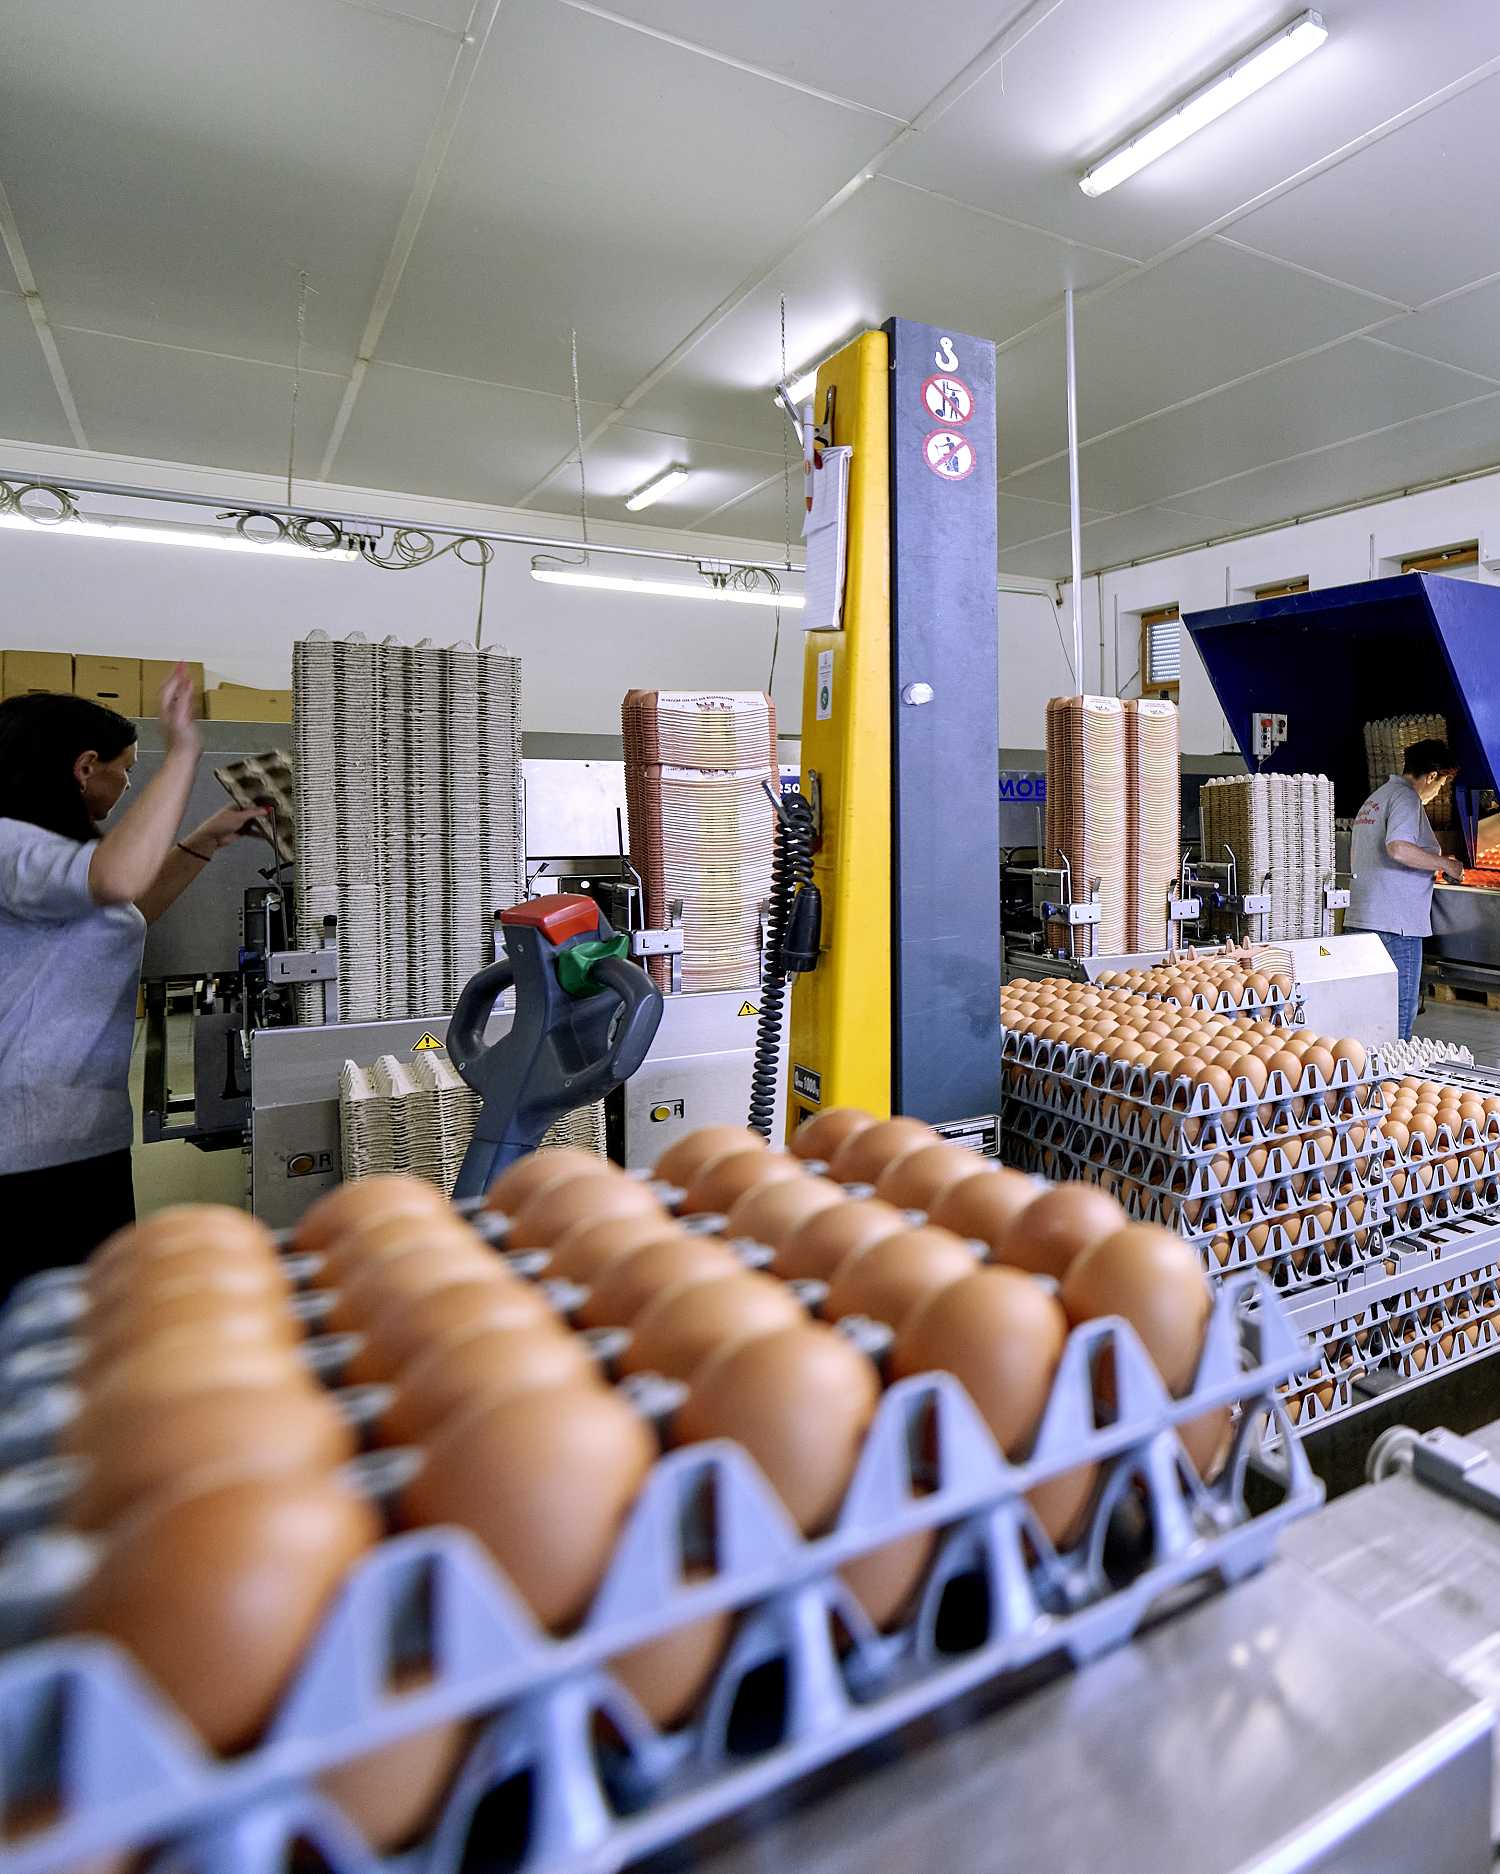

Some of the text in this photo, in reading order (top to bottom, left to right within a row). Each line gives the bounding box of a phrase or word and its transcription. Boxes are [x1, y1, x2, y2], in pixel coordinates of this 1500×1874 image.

[1074, 910, 1080, 919] L
[1190, 905, 1196, 914] L
[642, 938, 650, 949] L
[280, 962, 291, 975] L
[673, 1104, 683, 1117] R
[319, 1153, 331, 1168] R
